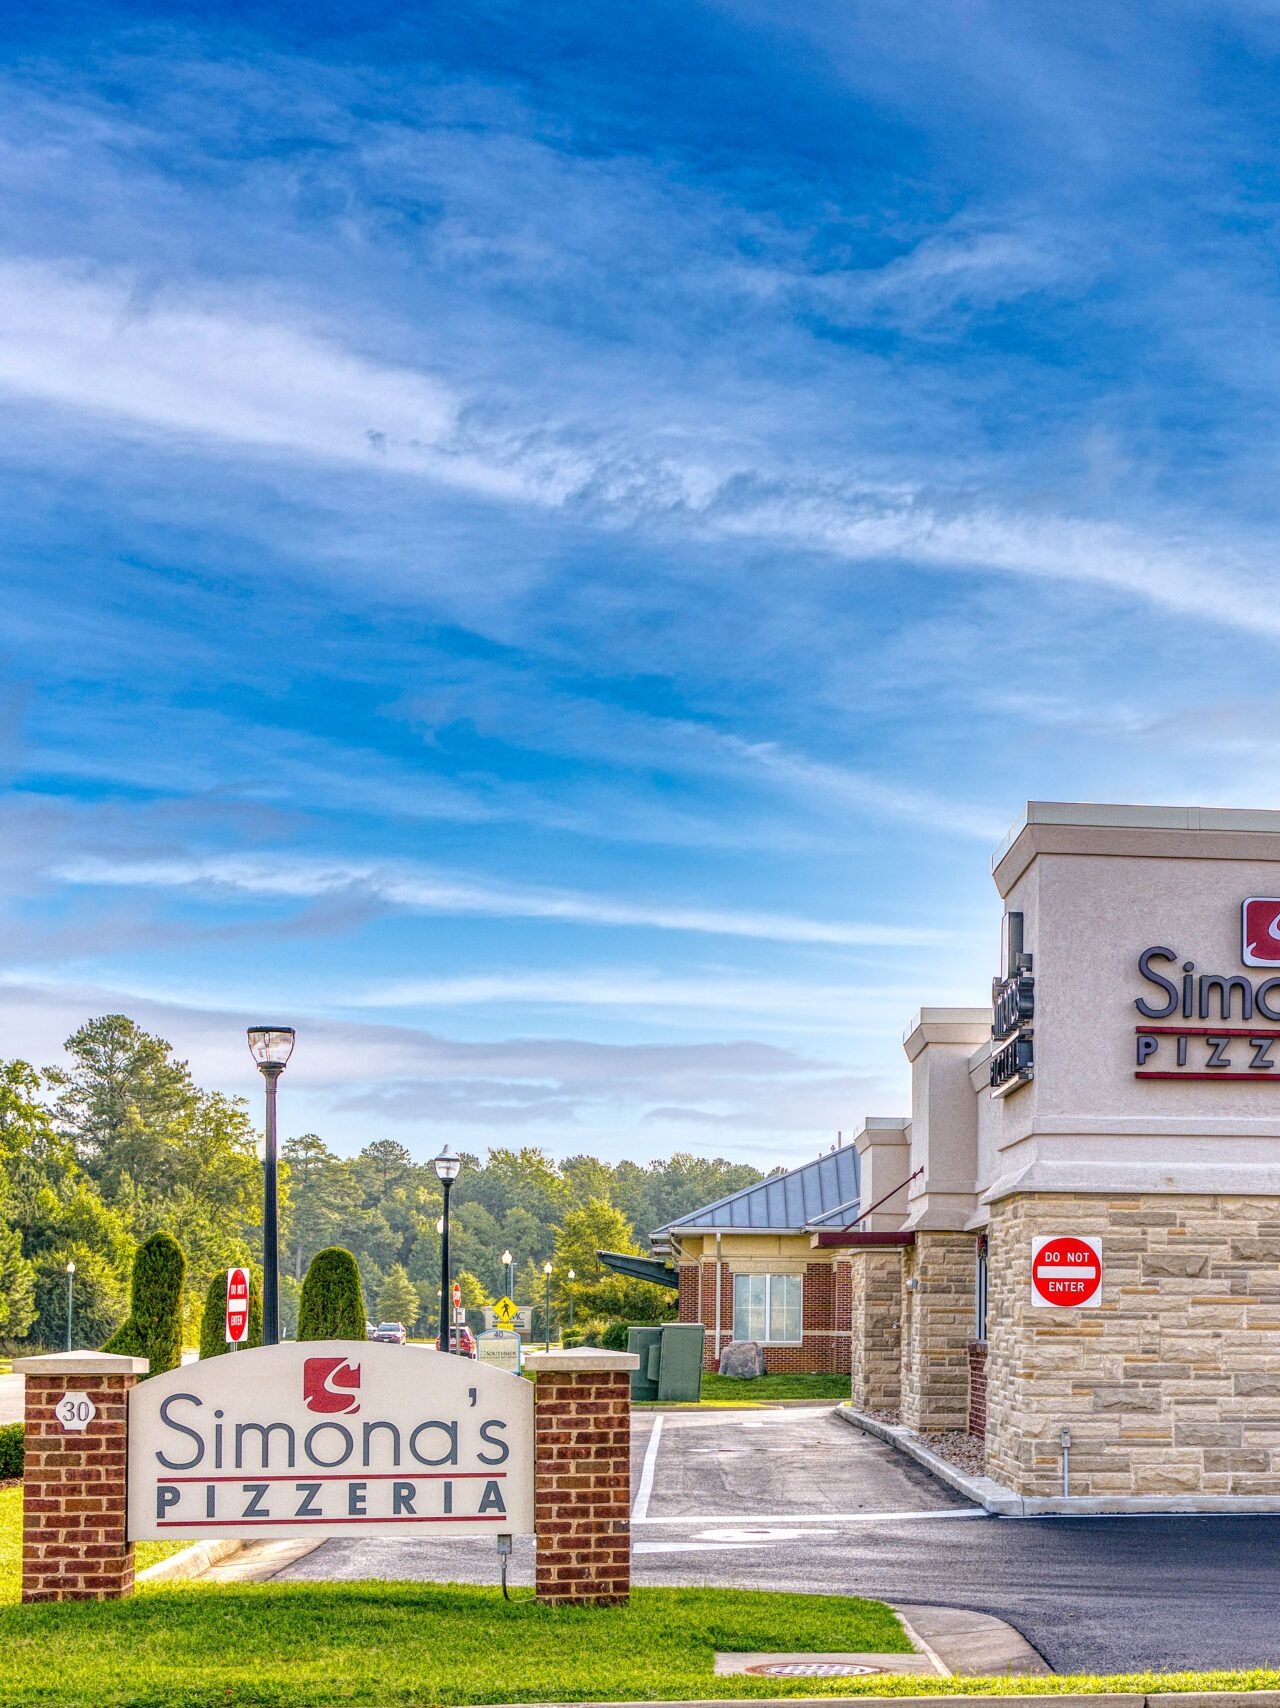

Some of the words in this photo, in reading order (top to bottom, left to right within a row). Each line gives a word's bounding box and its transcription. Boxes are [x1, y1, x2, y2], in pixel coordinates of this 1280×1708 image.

[1045, 1251, 1060, 1263] DO
[1067, 1252, 1090, 1263] NOT
[230, 1284, 237, 1295] DO
[237, 1284, 246, 1295] NOT
[1048, 1281, 1085, 1292] ENTER
[230, 1315, 243, 1326] ENTER
[494, 1330, 504, 1339] 40
[62, 1401, 90, 1422] 30
[155, 1388, 510, 1470] Simona's
[156, 1480, 507, 1519] PIZZERIA
